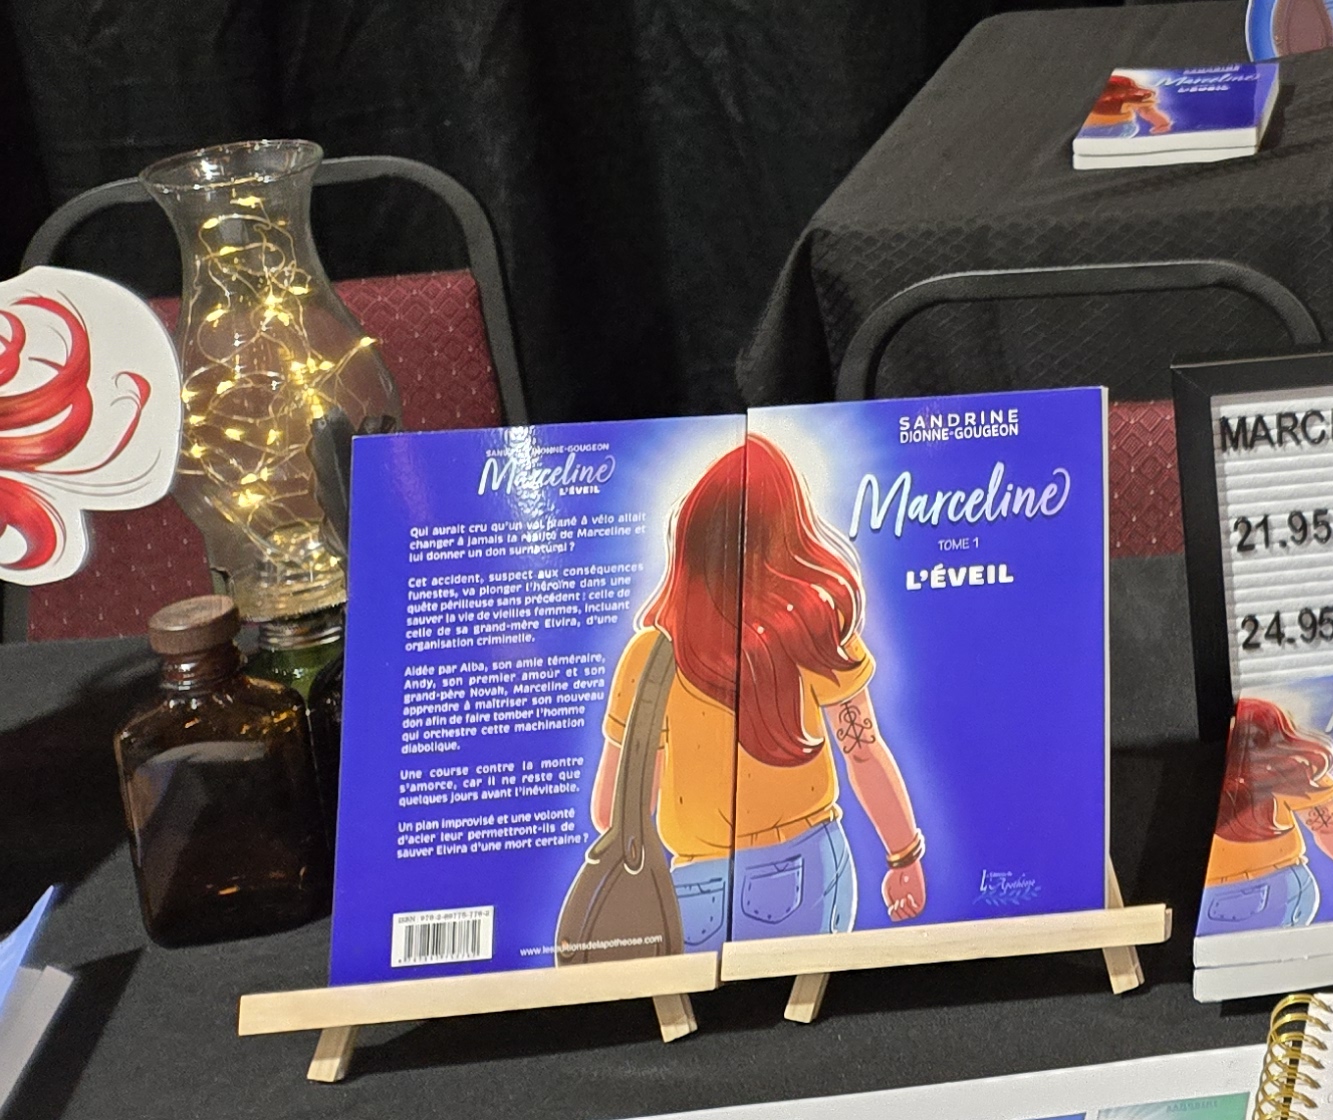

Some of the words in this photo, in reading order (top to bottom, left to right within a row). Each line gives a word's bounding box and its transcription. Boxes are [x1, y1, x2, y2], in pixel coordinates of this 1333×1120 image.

[900, 409, 1018, 430] SANDRINE
[900, 424, 1018, 444] DIONNE-GOUGEON
[478, 453, 616, 495] Marceline
[559, 486, 600, 496] L'ÉVEIL
[849, 461, 1070, 538] Marceline
[938, 539, 970, 551] TOME
[973, 537, 980, 548] 1
[1233, 509, 1332, 553] 21.95
[408, 578, 426, 588] Cet
[431, 574, 484, 589] accident,
[488, 570, 532, 585] suspect
[537, 570, 558, 579] aux
[562, 562, 645, 579] conséquences
[906, 563, 1014, 590] L'ÉVEIL
[406, 601, 438, 615] quête
[440, 598, 494, 613] périlleuse
[497, 598, 521, 606] sans
[524, 591, 580, 607] précédent
[588, 589, 614, 600] celle
[616, 588, 630, 598] de
[408, 588, 458, 603] funestes,
[462, 589, 475, 597] va
[479, 583, 521, 598] plonger
[525, 579, 575, 592] l'héroïne
[580, 577, 605, 588] dans
[610, 577, 631, 586] une
[405, 627, 431, 638] celle
[437, 626, 450, 636] de
[456, 627, 468, 635] sa
[473, 620, 539, 636] grand-mère
[544, 617, 580, 631] Elvira,
[586, 614, 618, 625] d'une
[406, 616, 443, 626] sauver
[445, 613, 455, 623] la
[458, 612, 474, 622] vie
[476, 611, 490, 621] de
[492, 608, 530, 619] vieilles
[534, 604, 581, 619] femmes,
[584, 601, 631, 613] incluant
[405, 638, 473, 653] organisation
[476, 634, 534, 646] criminelle.
[404, 666, 434, 677] Aidée
[438, 666, 457, 677] par
[459, 662, 488, 675] Alba,
[492, 662, 511, 671] son
[515, 658, 543, 669] amie
[547, 654, 605, 669] téméraire,
[403, 679, 435, 693] Andy,
[442, 679, 462, 687] son
[468, 672, 516, 688] premier
[521, 671, 560, 681] amour
[565, 667, 577, 677] et
[584, 667, 605, 676] son
[403, 690, 465, 706] grand-père
[469, 686, 507, 701] Novah,
[512, 681, 568, 695] Marceline
[573, 678, 604, 690] devra
